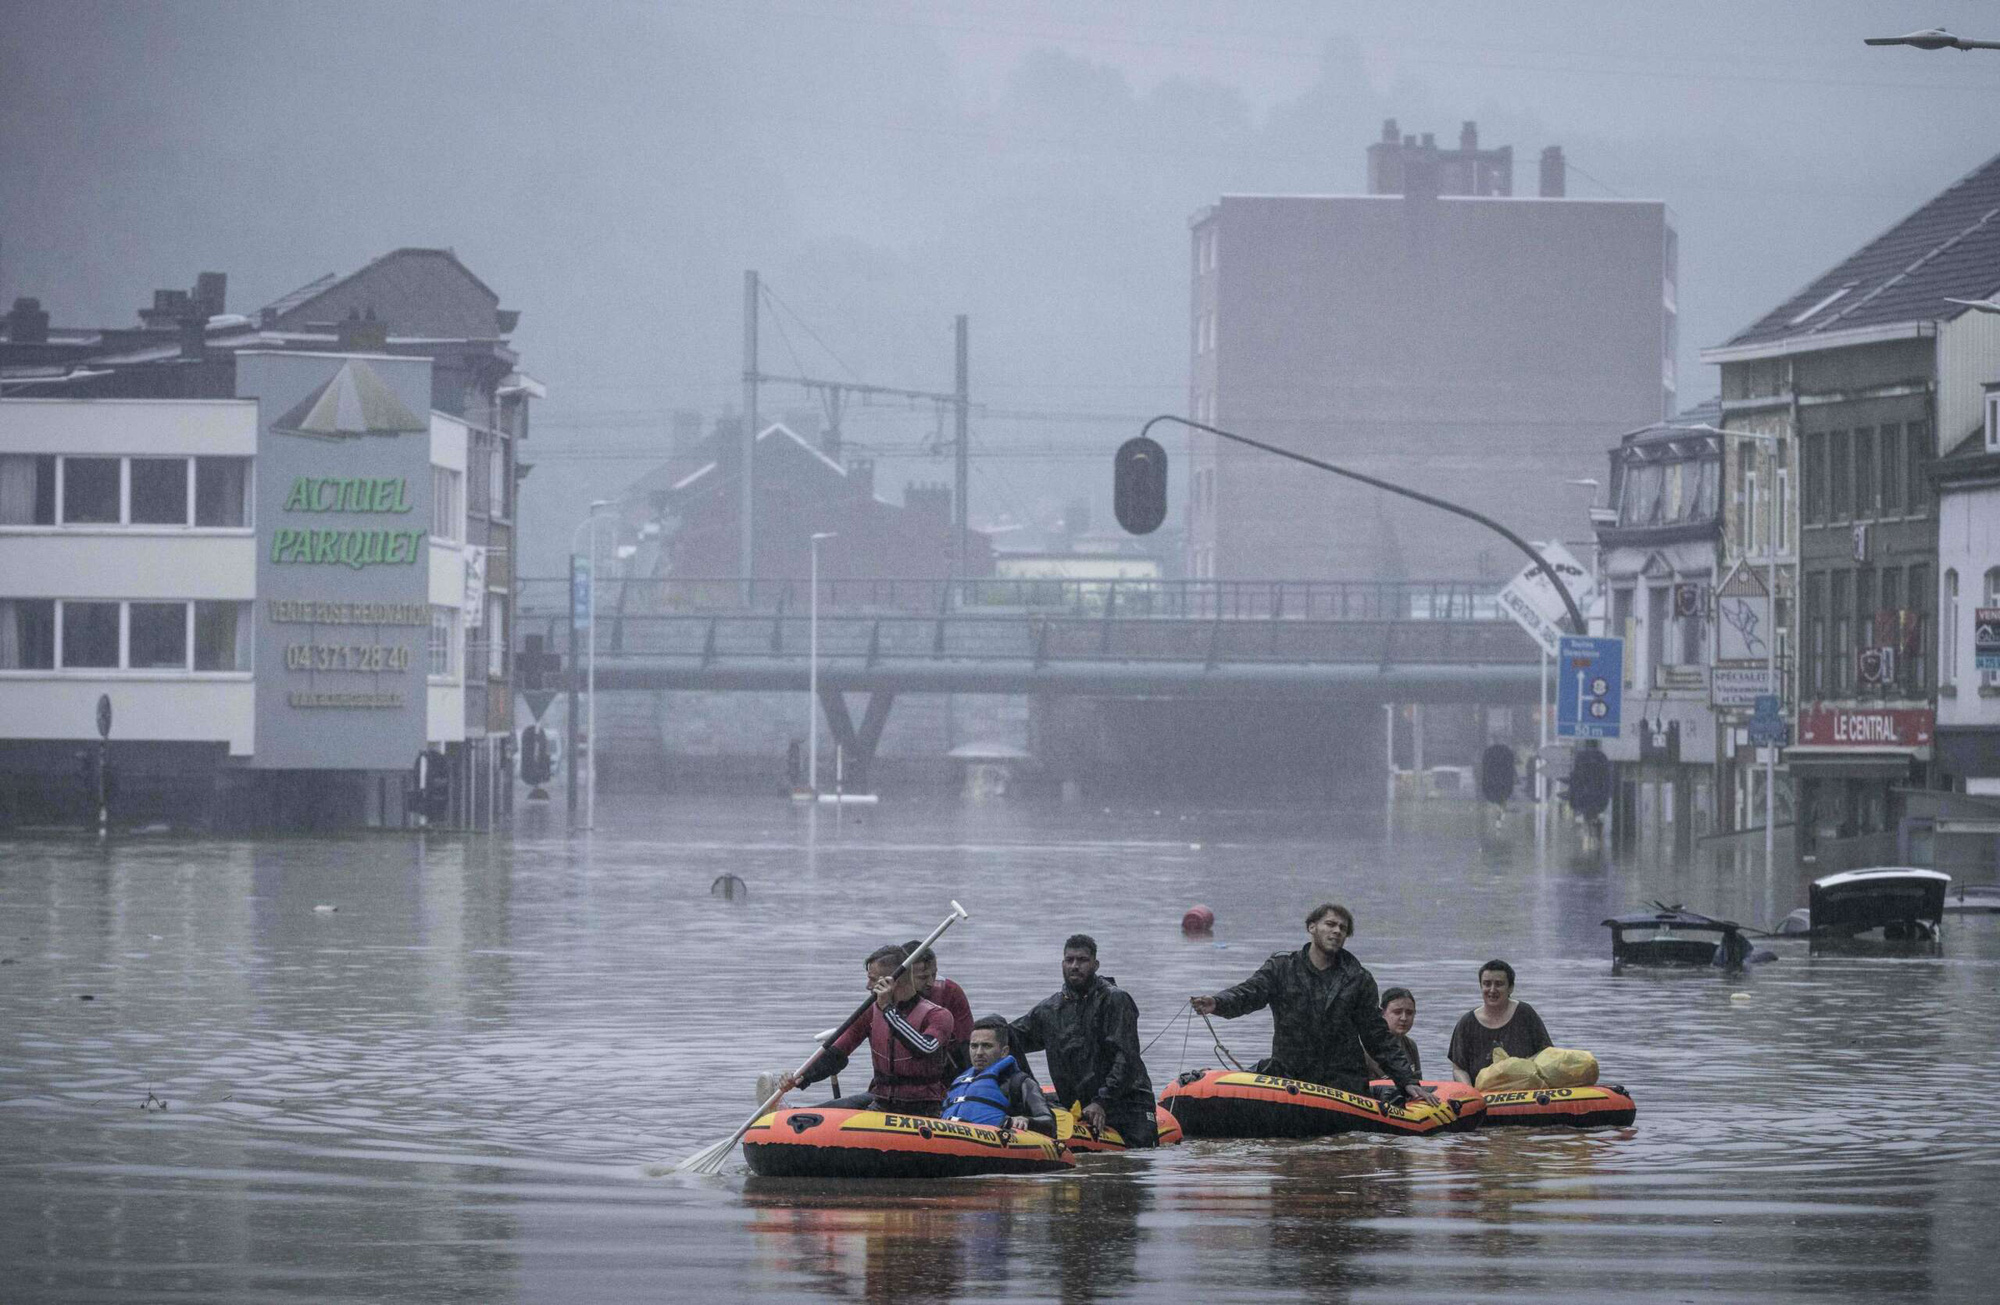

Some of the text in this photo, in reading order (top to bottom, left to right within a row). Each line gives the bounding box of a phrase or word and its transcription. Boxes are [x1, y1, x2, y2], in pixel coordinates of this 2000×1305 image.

[284, 477, 412, 513] ACTUEL
[272, 529, 425, 569] PARQUET
[287, 643, 409, 670] 04 371 28 40
[1715, 671, 1778, 681] SPÉCIALITS
[1834, 715, 1897, 740] LE CENTRAL
[1255, 1074, 1344, 1100] EXPLORER
[1348, 1094, 1374, 1109] PRO
[1484, 1088, 1573, 1103] ORER PRO
[885, 1114, 972, 1137] EXPLORER
[974, 1128, 996, 1142] PRO
[1072, 1124, 1087, 1136] RO
